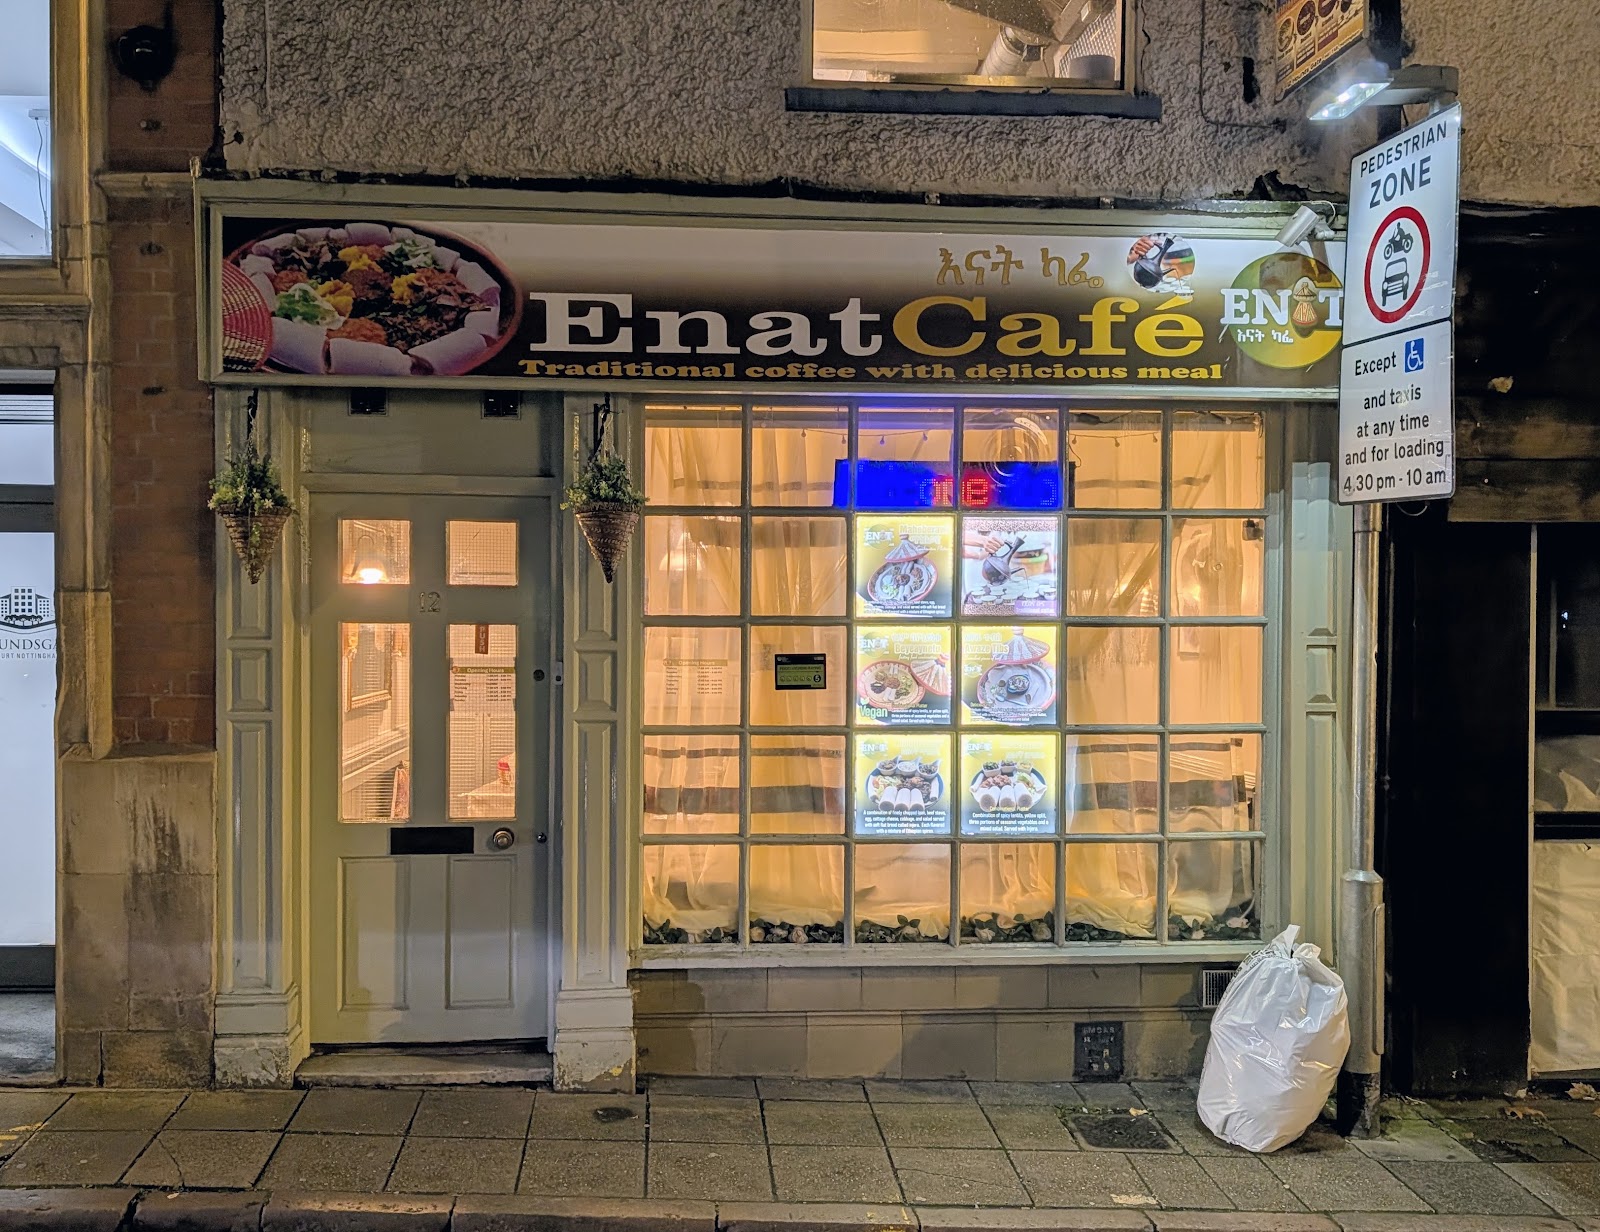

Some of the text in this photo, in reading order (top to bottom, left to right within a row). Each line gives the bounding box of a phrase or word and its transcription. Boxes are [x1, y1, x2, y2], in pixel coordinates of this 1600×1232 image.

[1360, 120, 1447, 178] PEDESTRIAN
[1369, 155, 1432, 209] ZONE
[936, 244, 1024, 287] እናት
[529, 291, 1205, 357] Enat Café
[518, 359, 1223, 380] Traditional coffee with delicious meal
[1355, 351, 1397, 377] Except
[1364, 387, 1421, 411] and taxis
[1357, 413, 1430, 441] at any time
[1345, 437, 1445, 466] and for loading
[1344, 472, 1373, 493] 4.30
[1375, 474, 1396, 493] pm
[1406, 468, 1422, 486] 10
[1425, 467, 1447, 485] am
[419, 592, 440, 613] 12
[0, 638, 55, 650] UNDSG
[860, 706, 888, 719] Vegan
